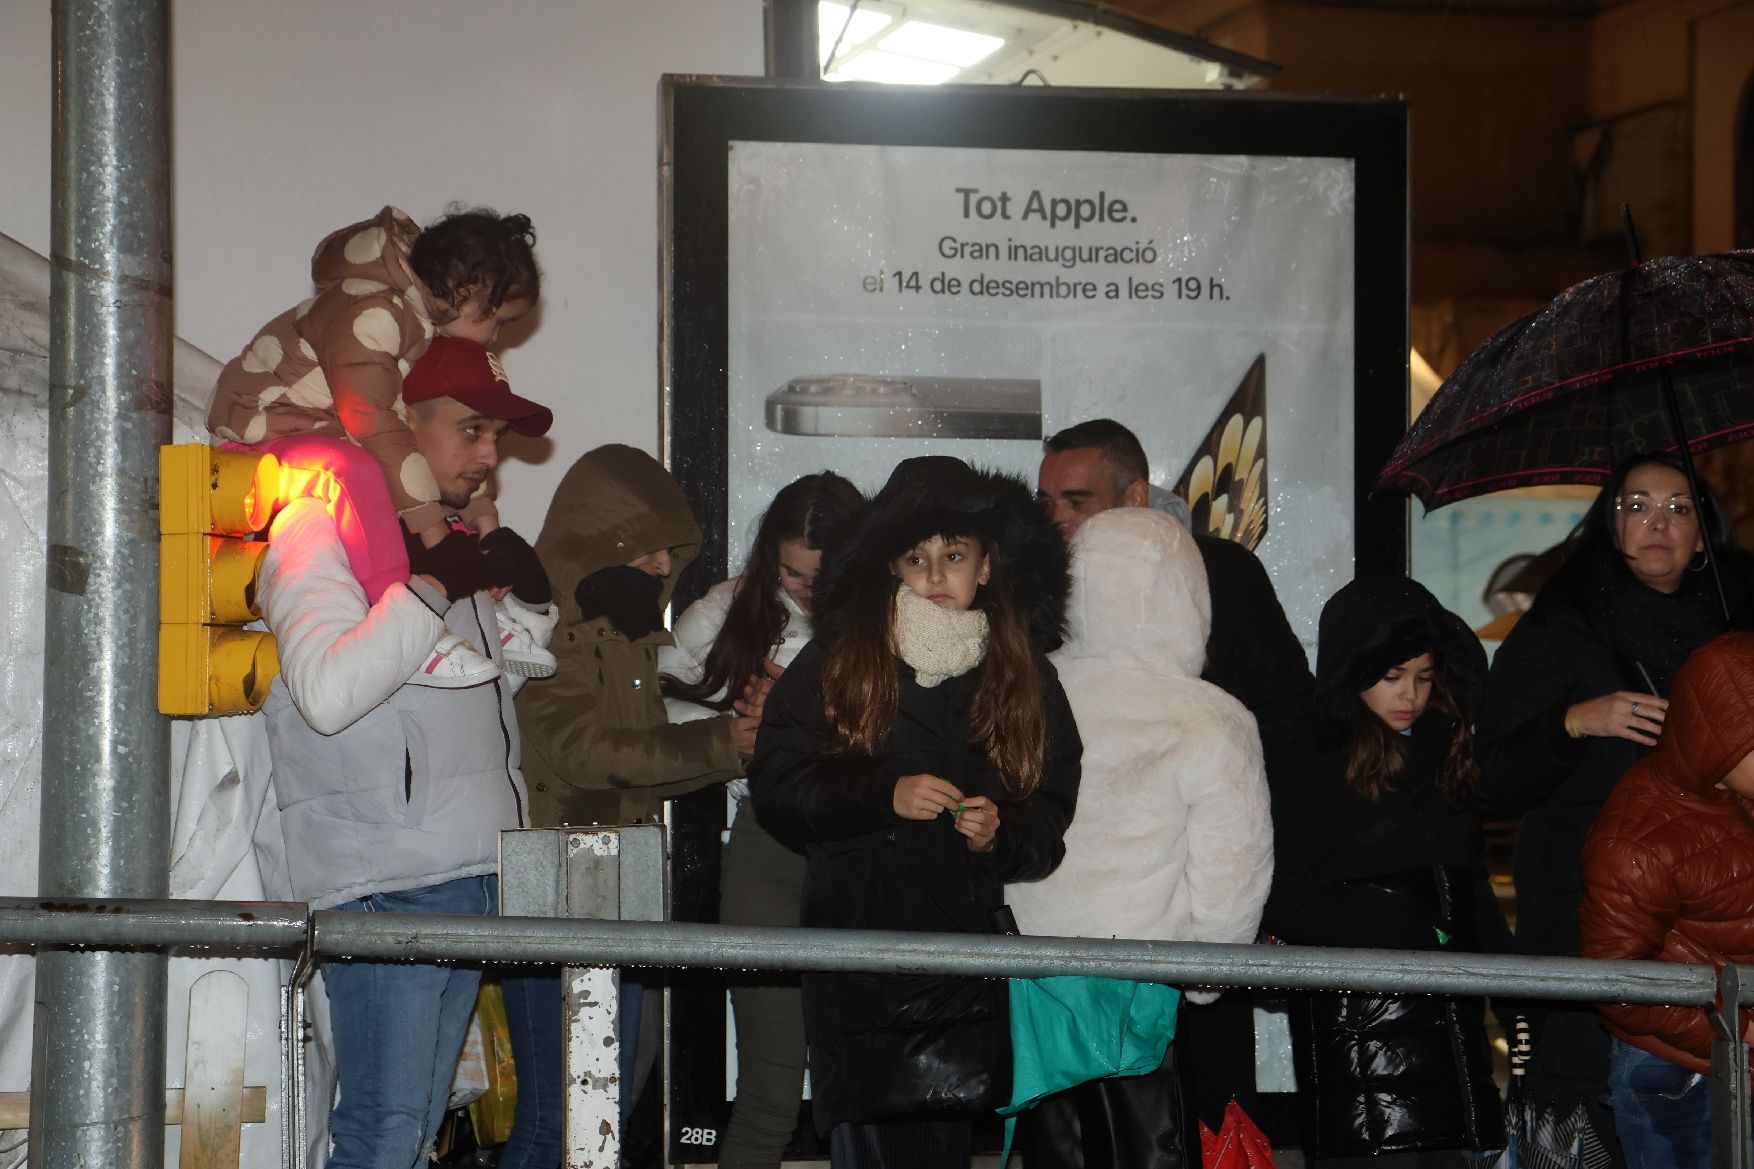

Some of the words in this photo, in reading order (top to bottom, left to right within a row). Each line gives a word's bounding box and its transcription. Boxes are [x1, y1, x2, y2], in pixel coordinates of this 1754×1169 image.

[955, 187, 1011, 220] Tot
[1022, 190, 1137, 229] Apple.
[938, 236, 999, 260] Gran
[1007, 238, 1157, 268] inauguració
[892, 270, 922, 294] 14
[930, 271, 961, 295] de
[969, 273, 1097, 299] desembre
[1104, 282, 1119, 299] a
[1128, 276, 1164, 300] les
[1172, 276, 1201, 300] 19
[1209, 277, 1230, 300] h.
[1517, 391, 1554, 410] TOUS
[1575, 373, 1616, 390] TOUS
[1634, 357, 1676, 374] TOUS
[1695, 345, 1737, 359] TOUS
[680, 1127, 717, 1146] 28B
